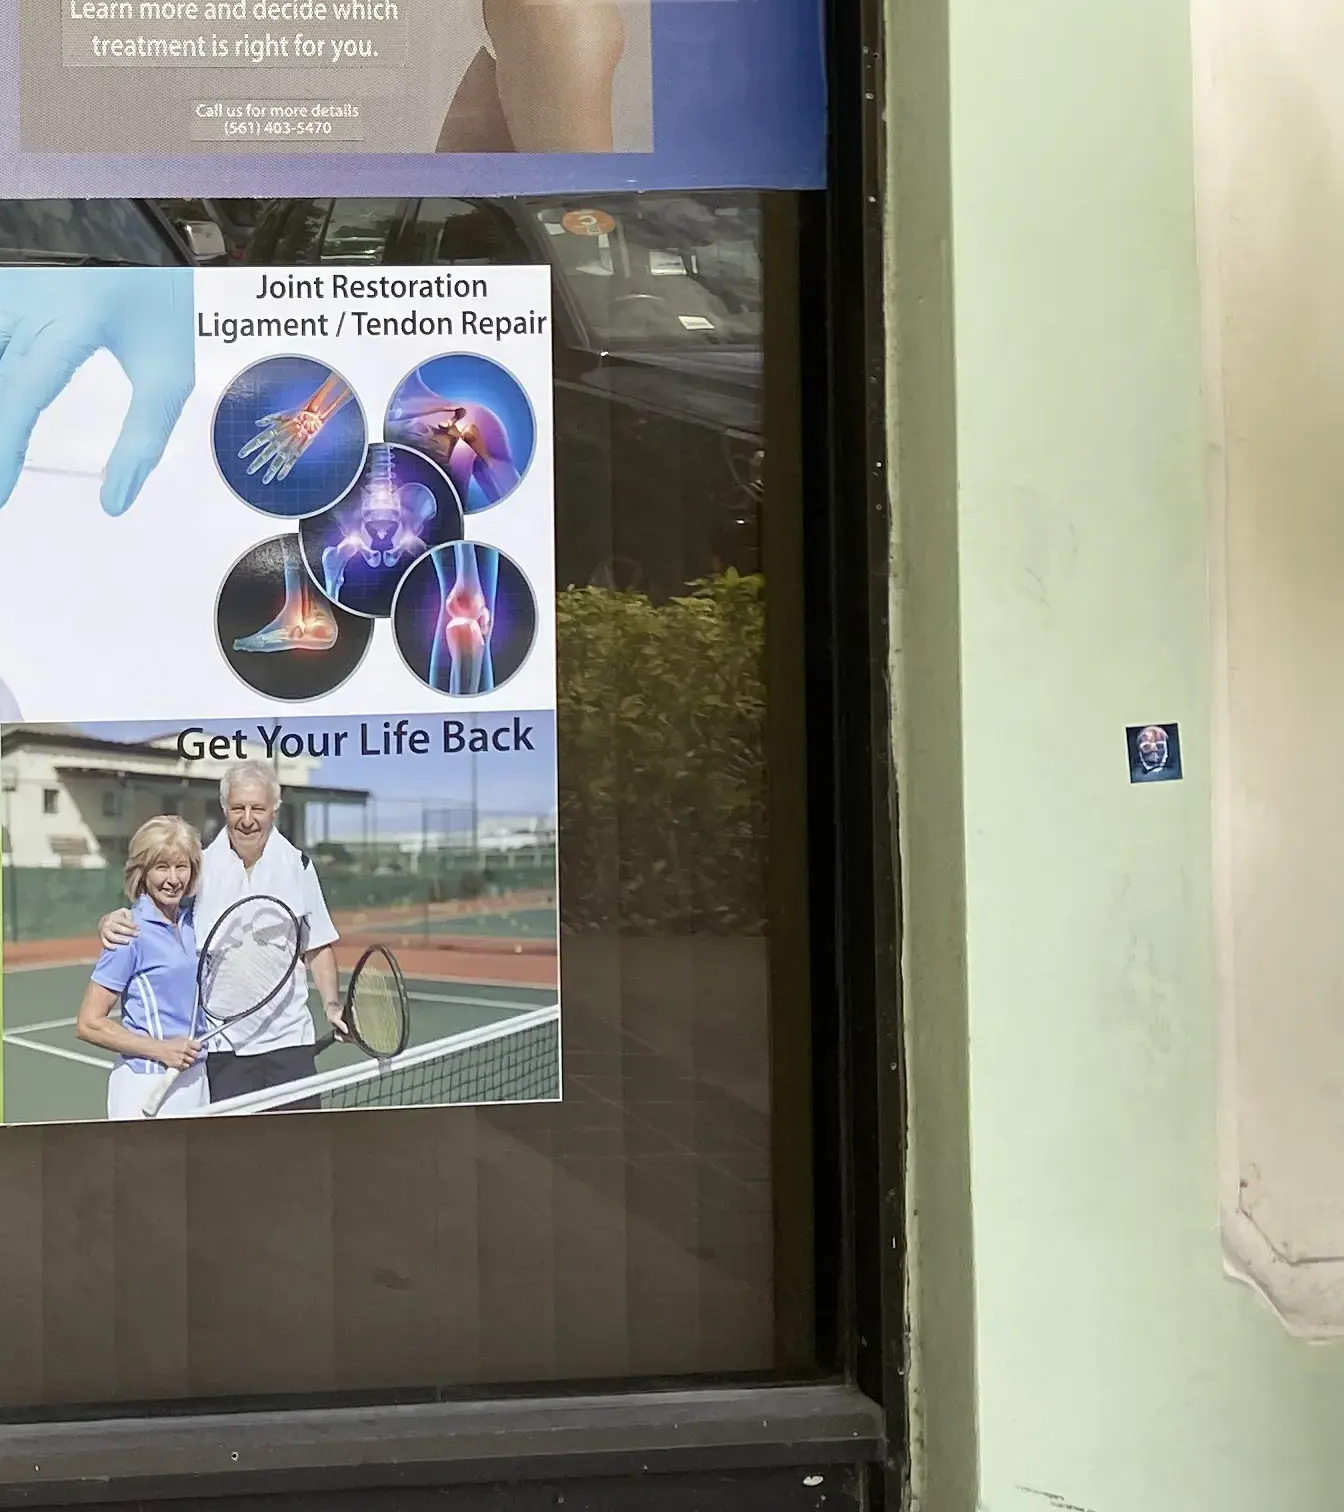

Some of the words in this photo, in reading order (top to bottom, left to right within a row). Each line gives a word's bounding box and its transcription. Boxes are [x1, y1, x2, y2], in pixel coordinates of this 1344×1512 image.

[140, 2, 197, 20] more
[92, 35, 205, 57] treatment
[235, 34, 288, 62] right
[294, 33, 325, 57] for
[331, 38, 379, 62] you.
[195, 103, 222, 118] Call
[271, 107, 308, 118] more
[311, 103, 359, 118] details
[224, 122, 260, 136] (561)
[264, 122, 332, 135] 403-5470
[256, 275, 324, 299] Joint
[333, 274, 488, 299] Restoration
[199, 312, 328, 343] Ligament
[351, 311, 452, 336] Tendon
[462, 310, 547, 341] Repair
[177, 727, 247, 760] Get
[257, 725, 348, 759] Your
[361, 720, 430, 756] Life
[443, 717, 535, 753] Back
